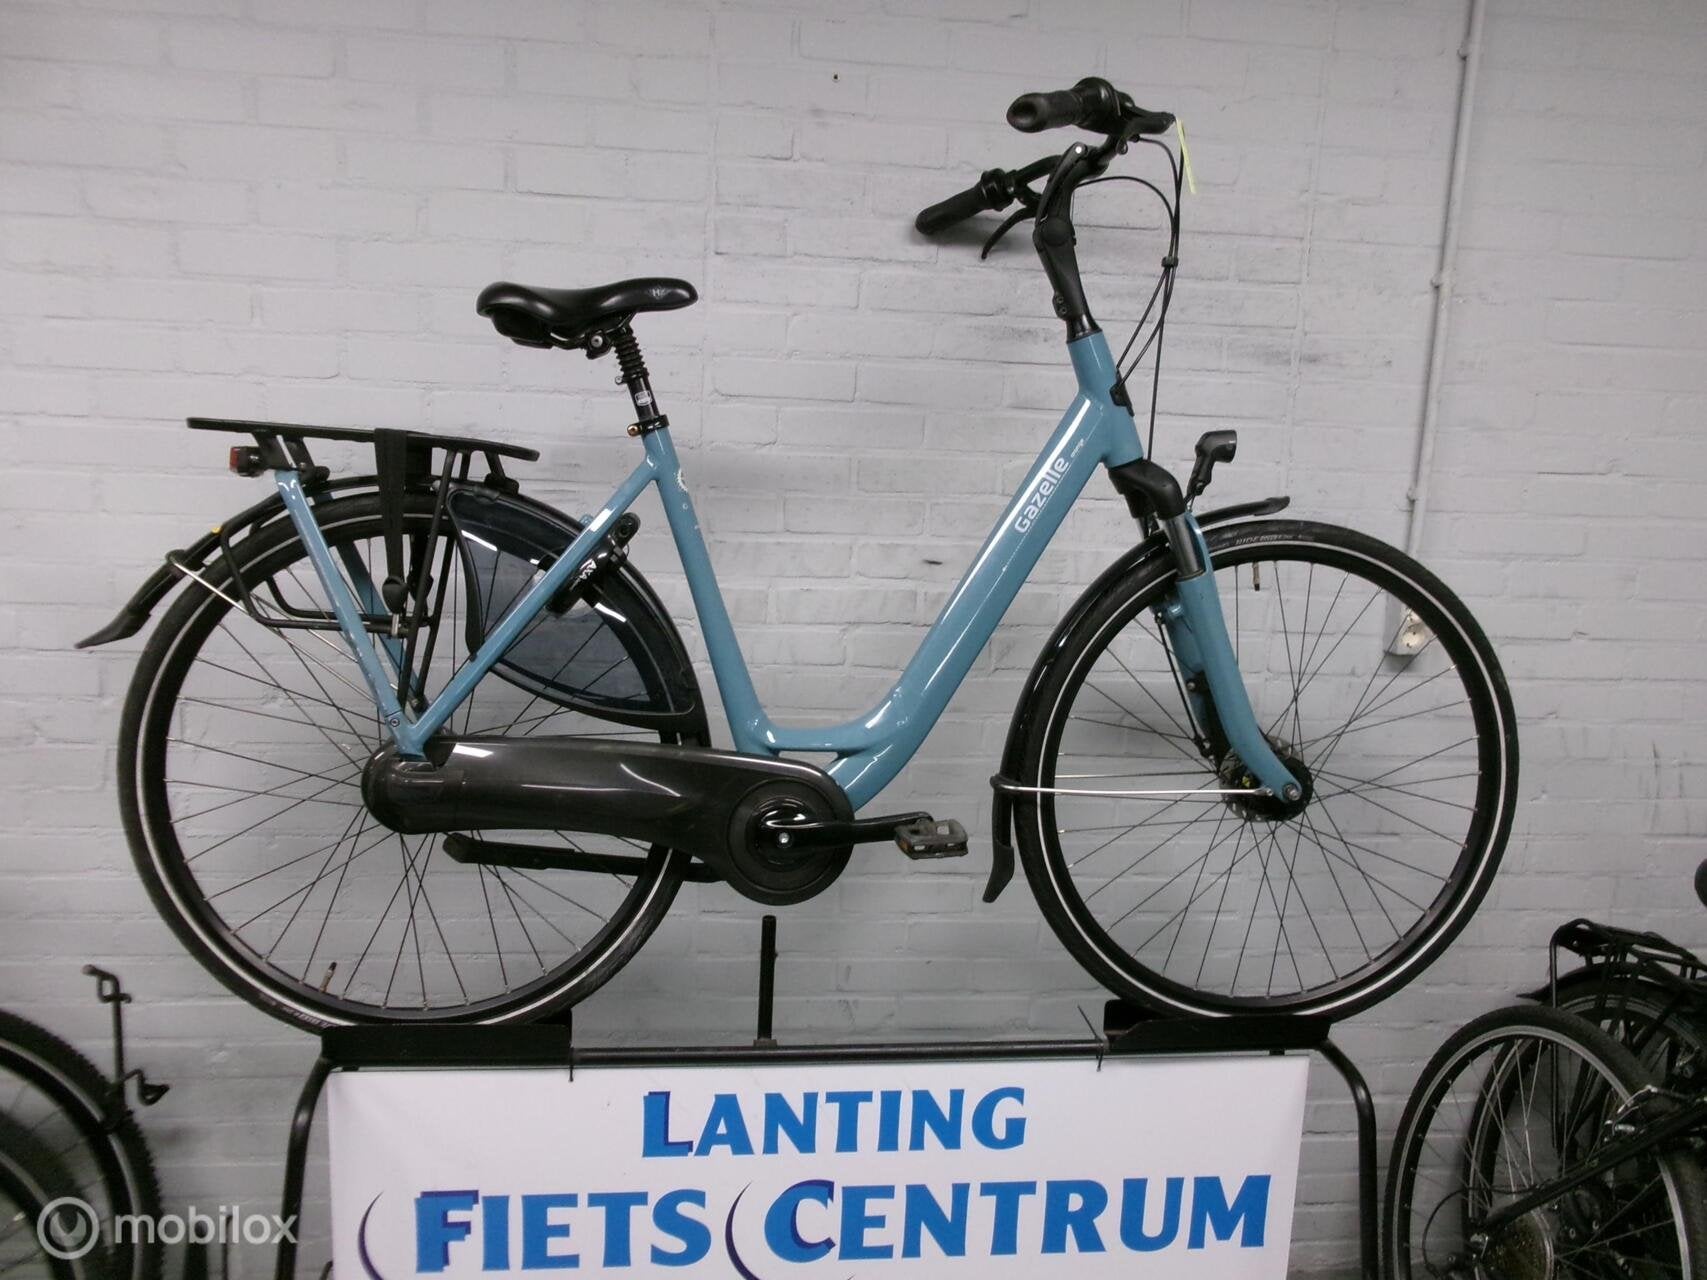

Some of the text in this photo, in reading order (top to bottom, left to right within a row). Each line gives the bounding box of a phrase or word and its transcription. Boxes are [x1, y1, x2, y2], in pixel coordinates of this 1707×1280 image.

[1014, 457, 1069, 533] Gazelle
[642, 1088, 1027, 1158] LANTING
[414, 1176, 1272, 1273] FIETS CENTRUM
